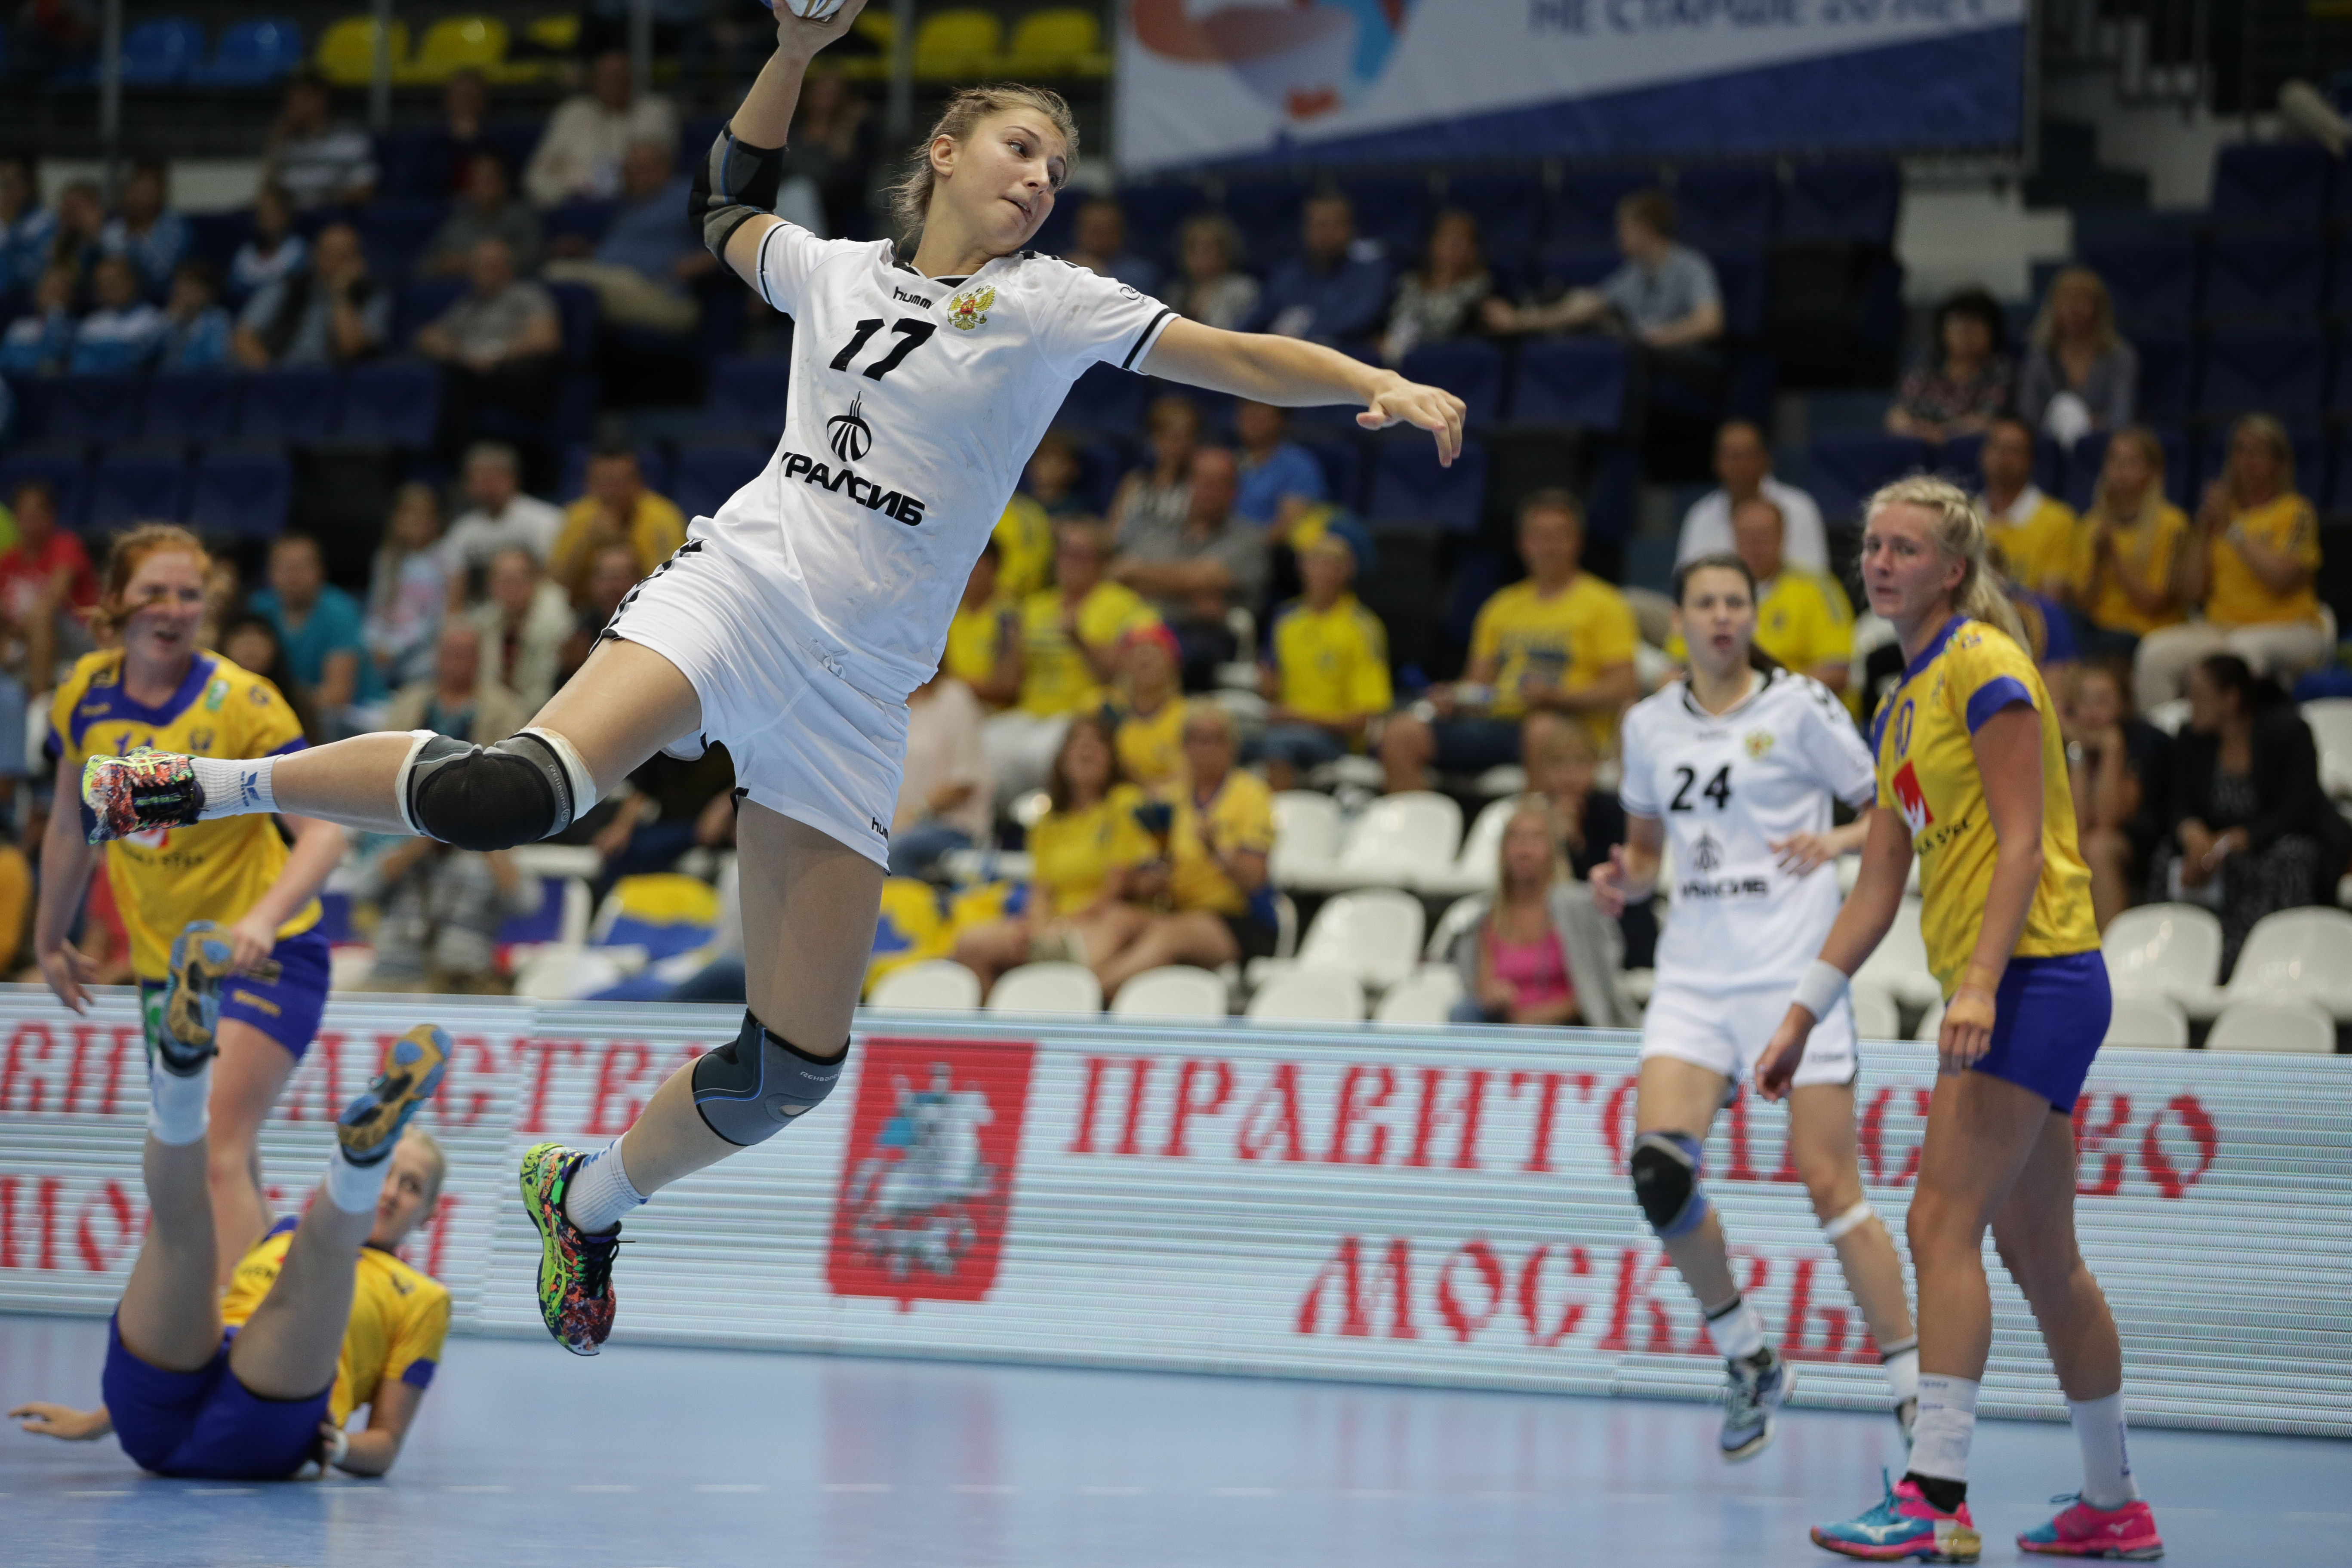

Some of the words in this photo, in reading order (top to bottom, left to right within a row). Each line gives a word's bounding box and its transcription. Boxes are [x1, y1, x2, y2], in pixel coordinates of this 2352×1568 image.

[893, 286, 935, 309] humm
[829, 318, 937, 382] 17
[1669, 763, 1733, 812] 24
[1063, 1053, 2217, 1199] ПРАВИТСВО
